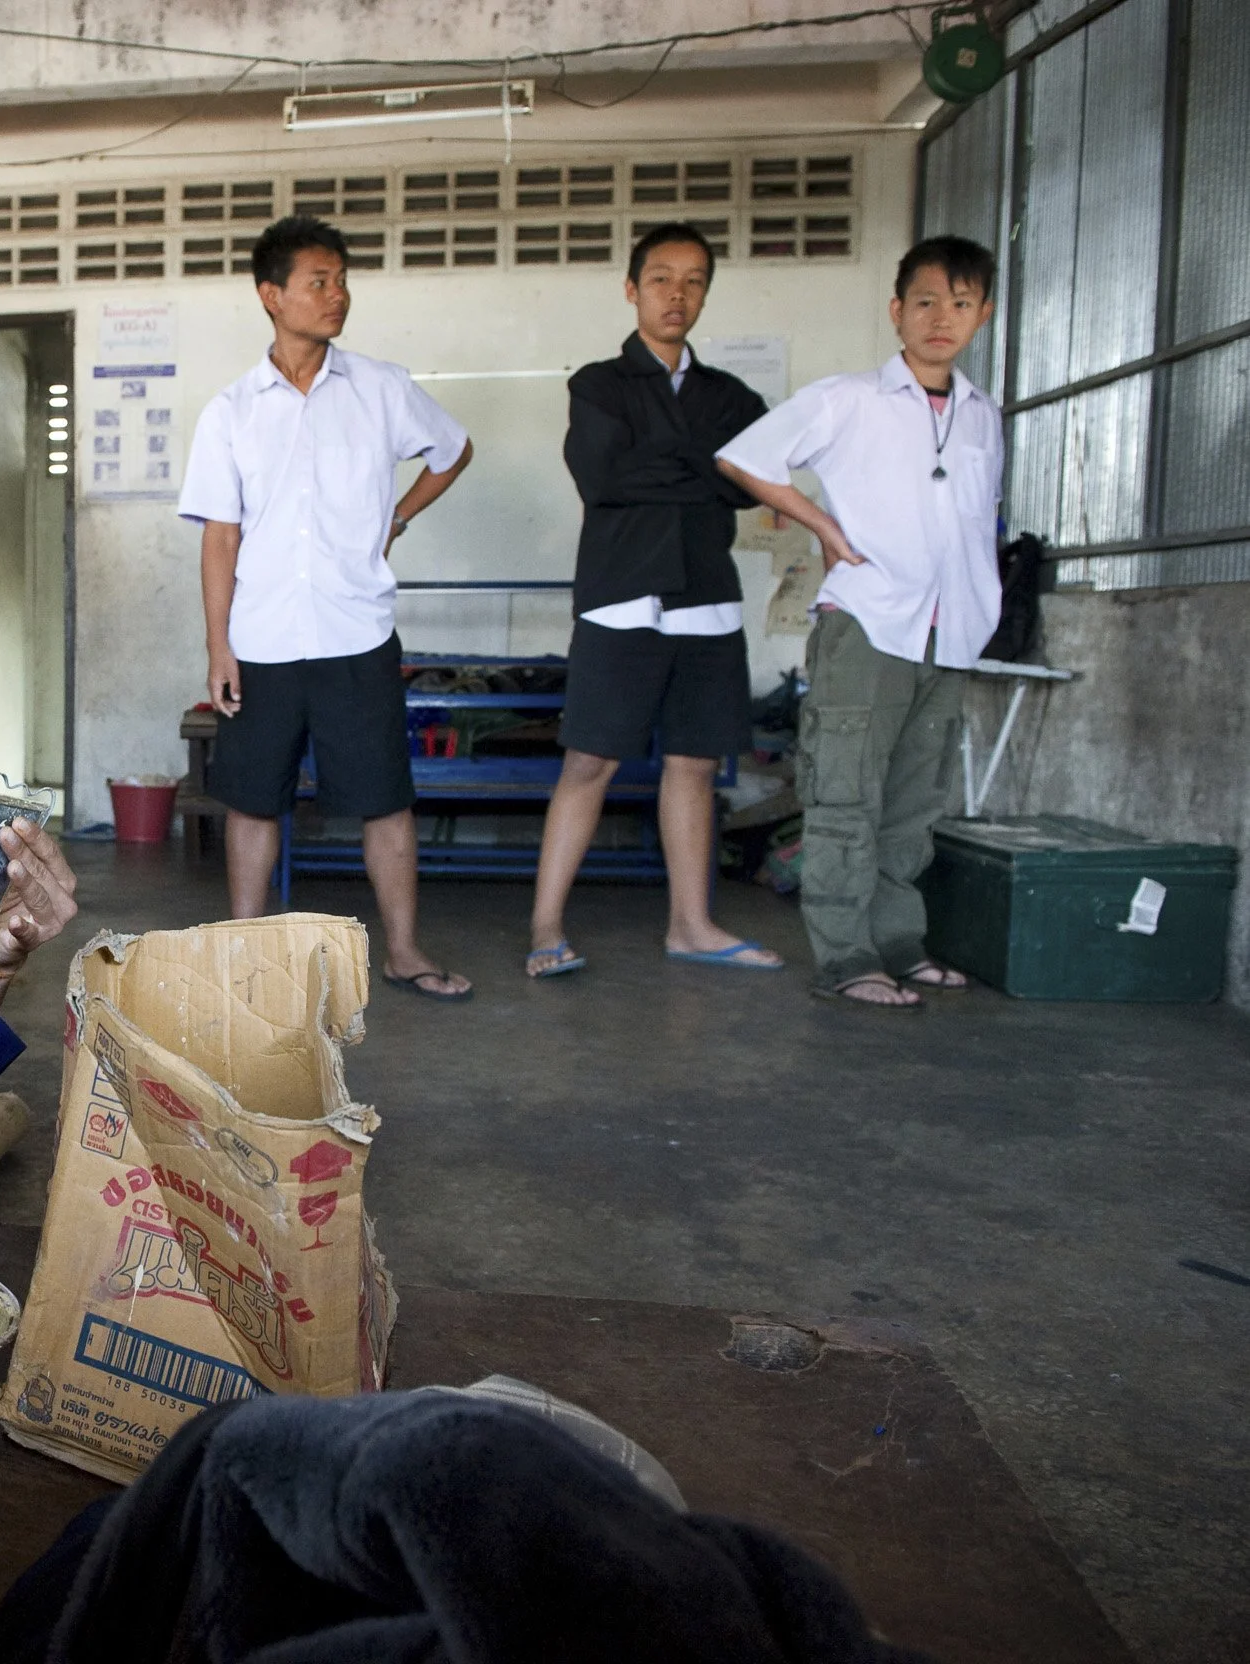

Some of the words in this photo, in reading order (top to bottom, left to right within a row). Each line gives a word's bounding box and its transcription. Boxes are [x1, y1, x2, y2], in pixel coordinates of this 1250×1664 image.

[131, 1198, 171, 1223] ตรา
[107, 1375, 131, 1392] 188
[141, 1389, 187, 1413] 50038
